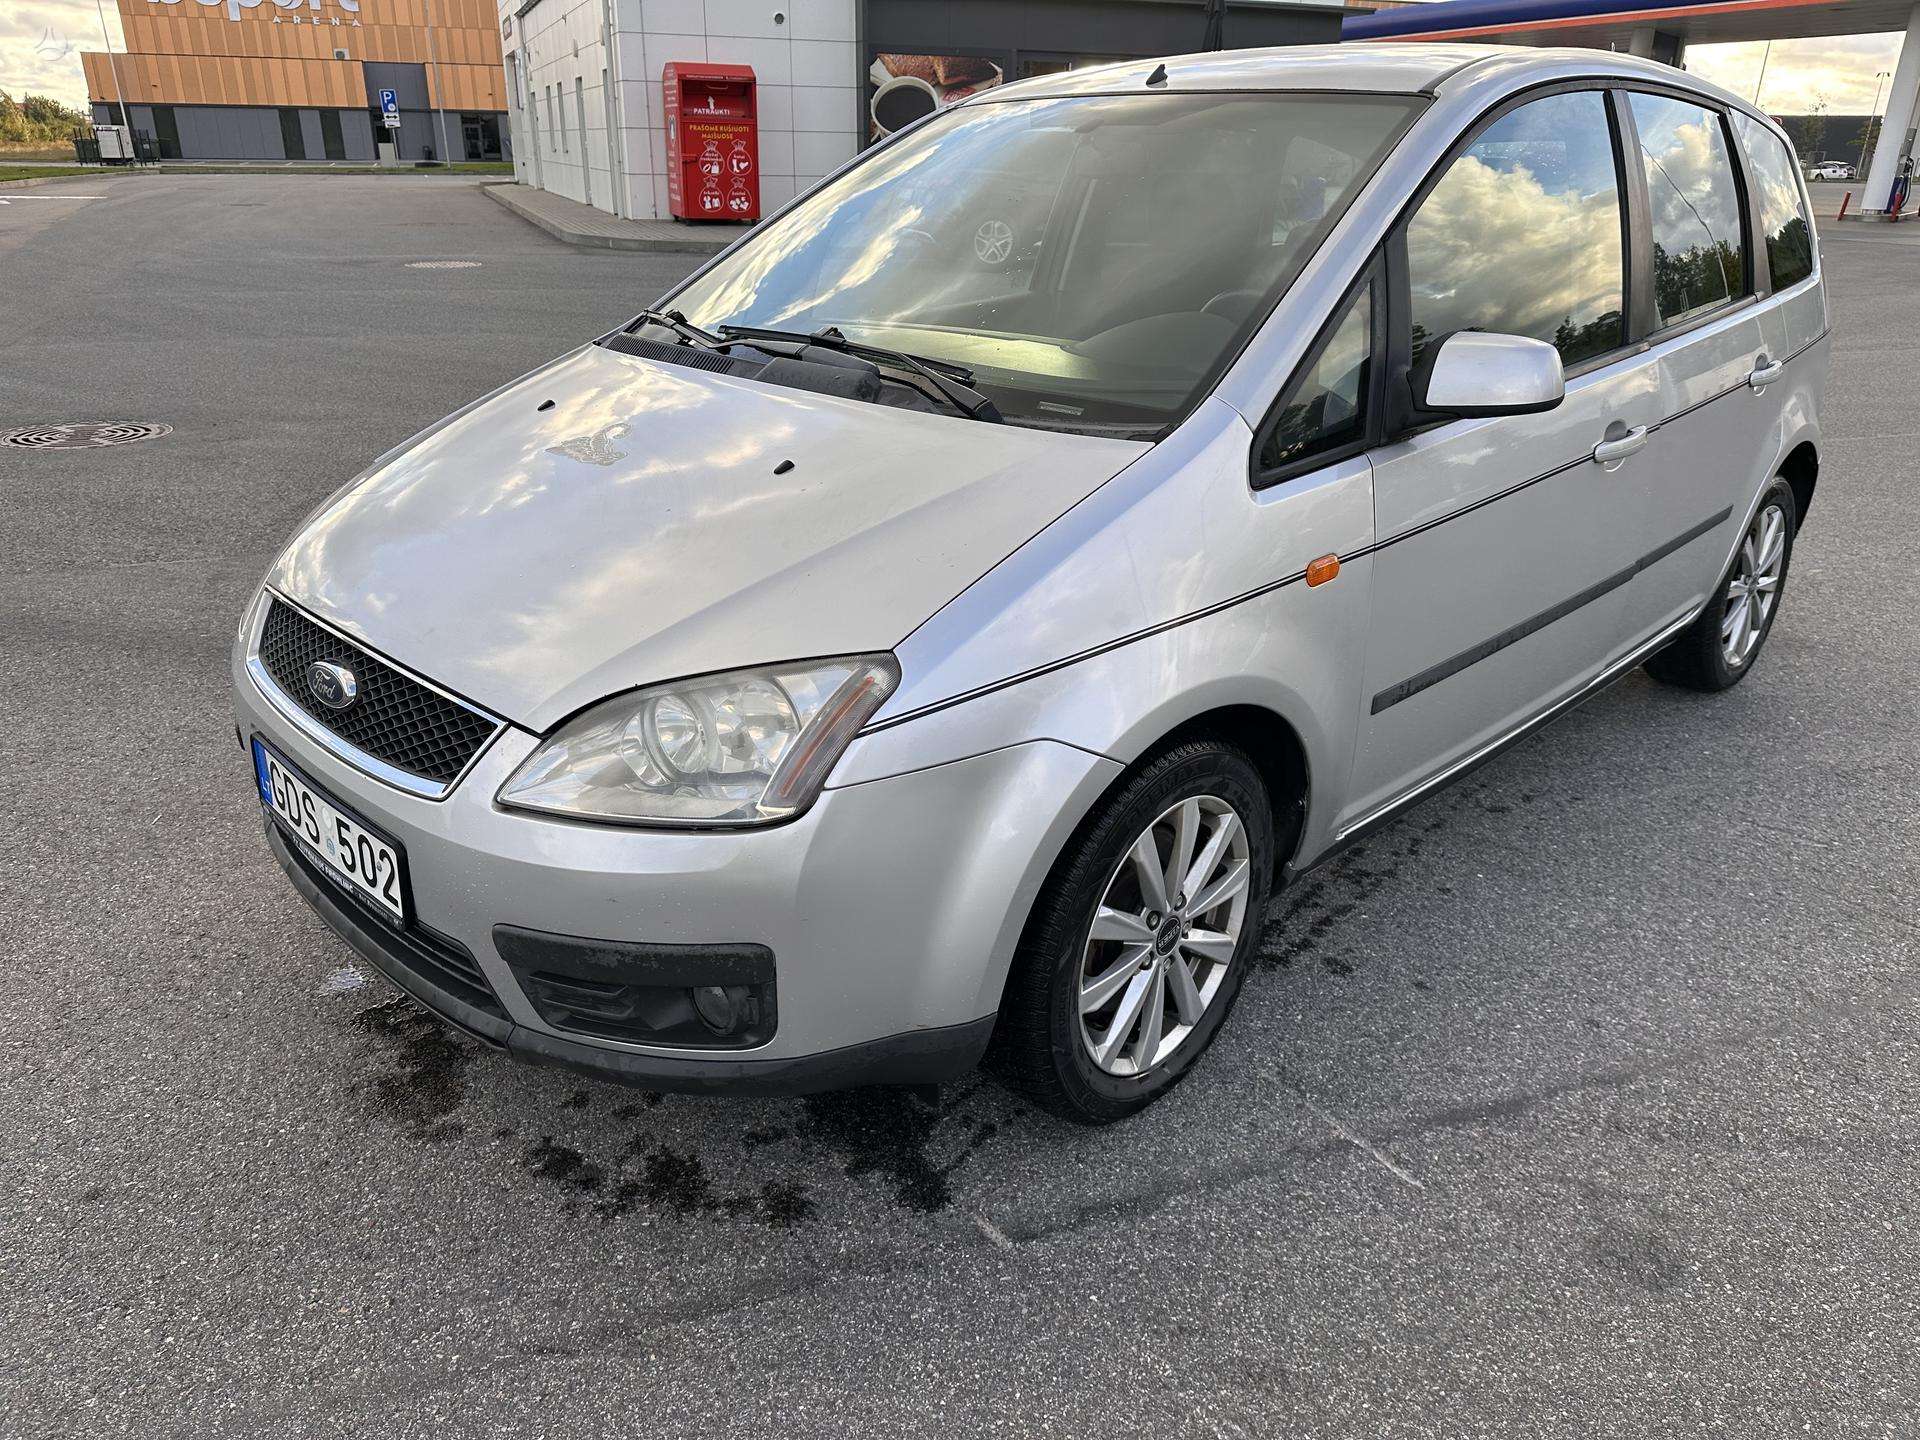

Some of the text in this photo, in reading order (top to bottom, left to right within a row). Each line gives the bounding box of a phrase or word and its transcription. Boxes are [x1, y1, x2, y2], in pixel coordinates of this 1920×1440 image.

[273, 15, 361, 27] ARENA
[383, 91, 392, 104] P
[693, 107, 730, 116] PATRAUKTI
[689, 124, 718, 132] PRAŠOME
[312, 669, 336, 700] Ford
[261, 776, 271, 790] LT
[269, 760, 400, 909] GDS 502
